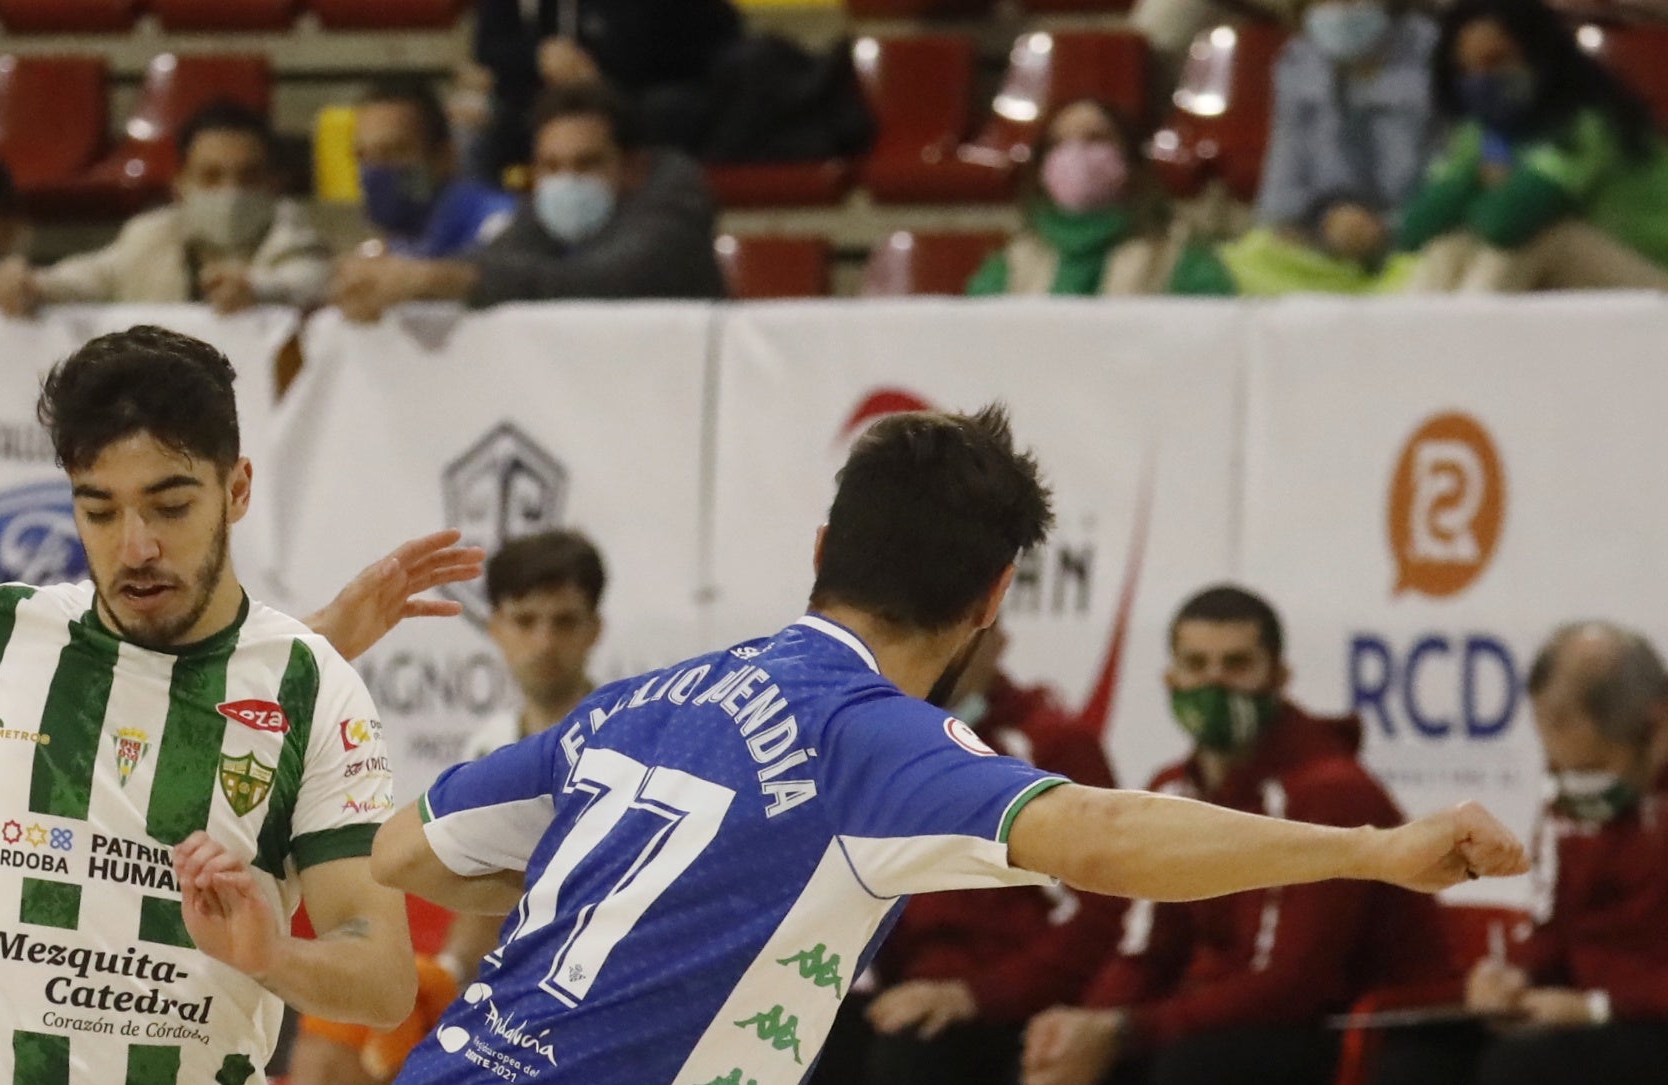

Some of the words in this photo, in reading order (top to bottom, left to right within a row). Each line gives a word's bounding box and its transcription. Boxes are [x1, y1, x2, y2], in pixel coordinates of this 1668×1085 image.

[483, 747, 737, 1009] 77
[45, 976, 214, 1025] Catedral
[42, 1011, 115, 1035] Corazón
[120, 1020, 141, 1037] de
[491, 1061, 517, 1084] 2021
